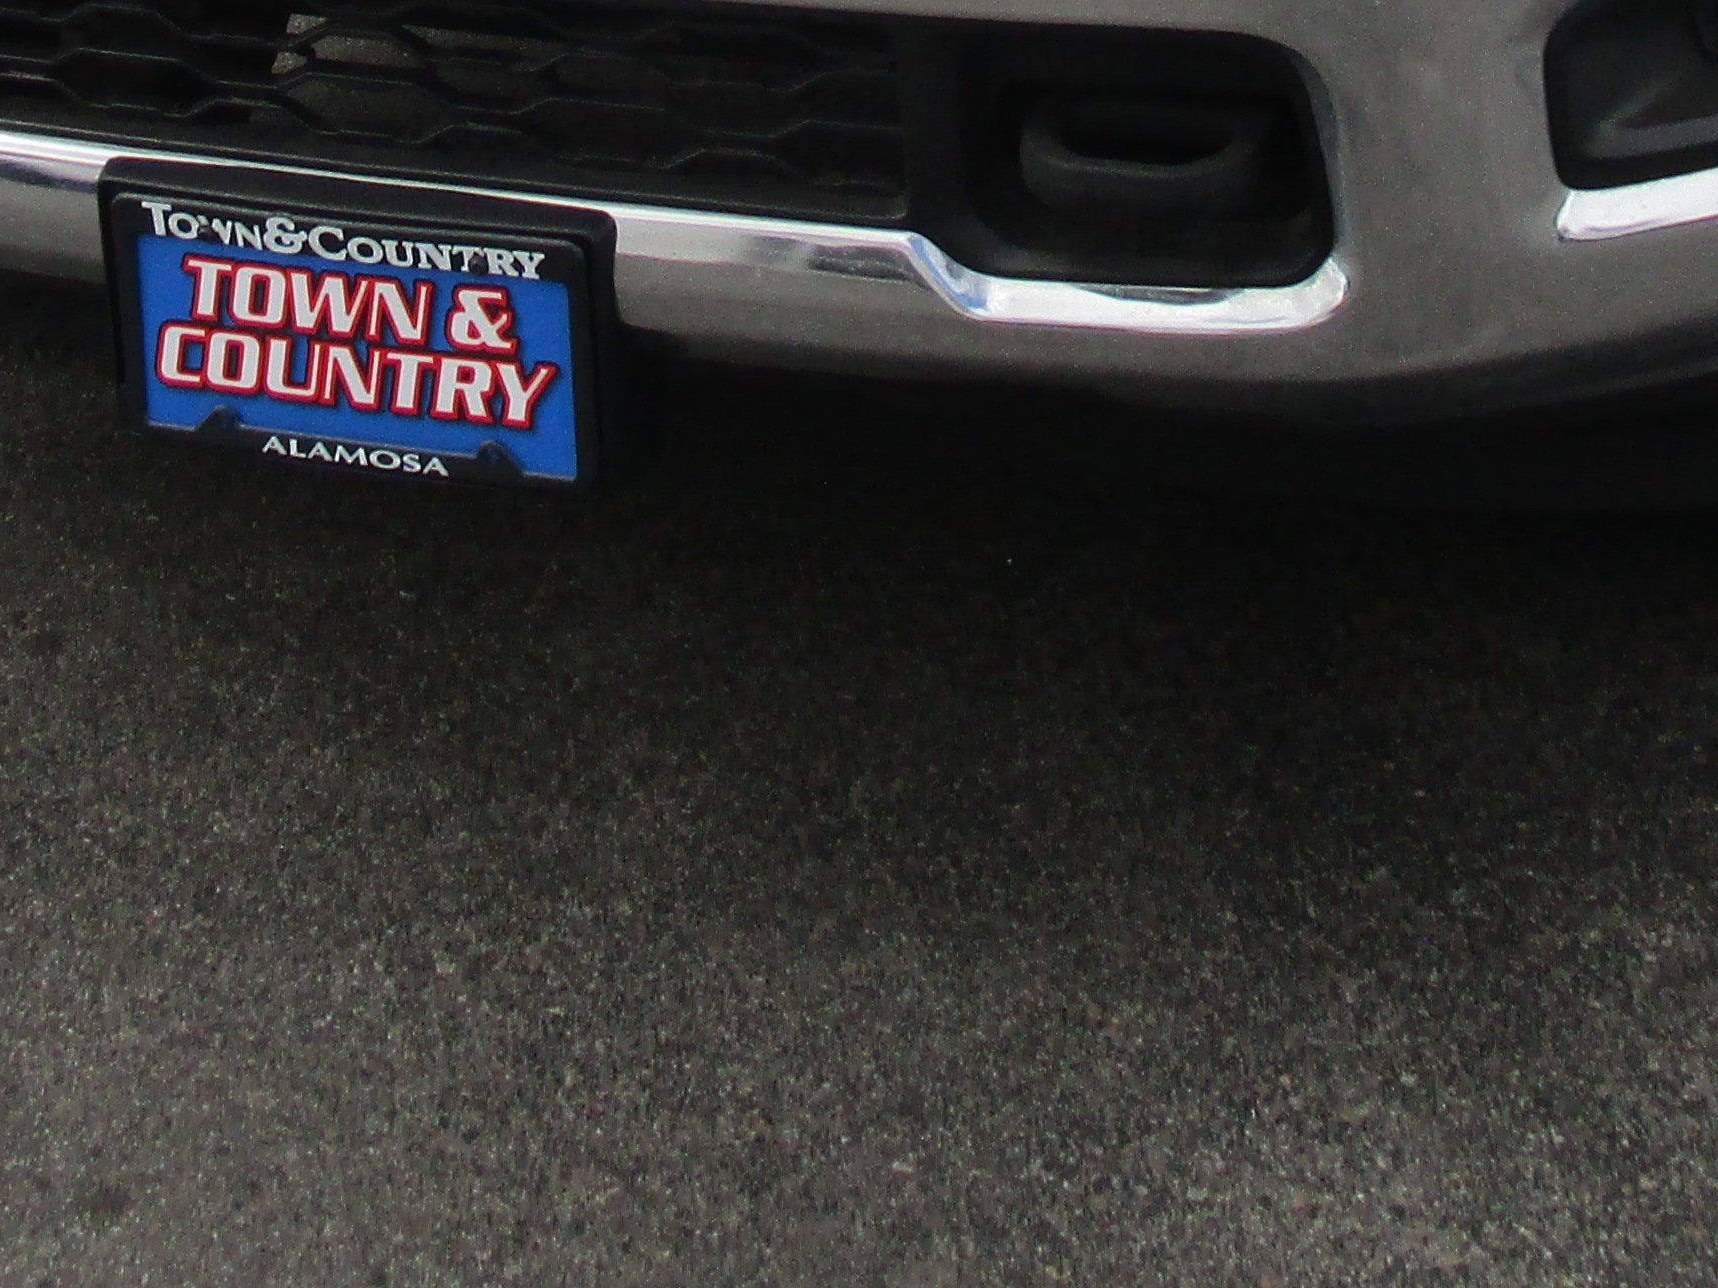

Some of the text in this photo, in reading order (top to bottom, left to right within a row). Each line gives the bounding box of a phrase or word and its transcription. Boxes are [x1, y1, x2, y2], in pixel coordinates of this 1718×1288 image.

[184, 254, 519, 355] TOWN &
[159, 323, 558, 428] COUNTRY
[262, 435, 451, 478] ALAMOSA
